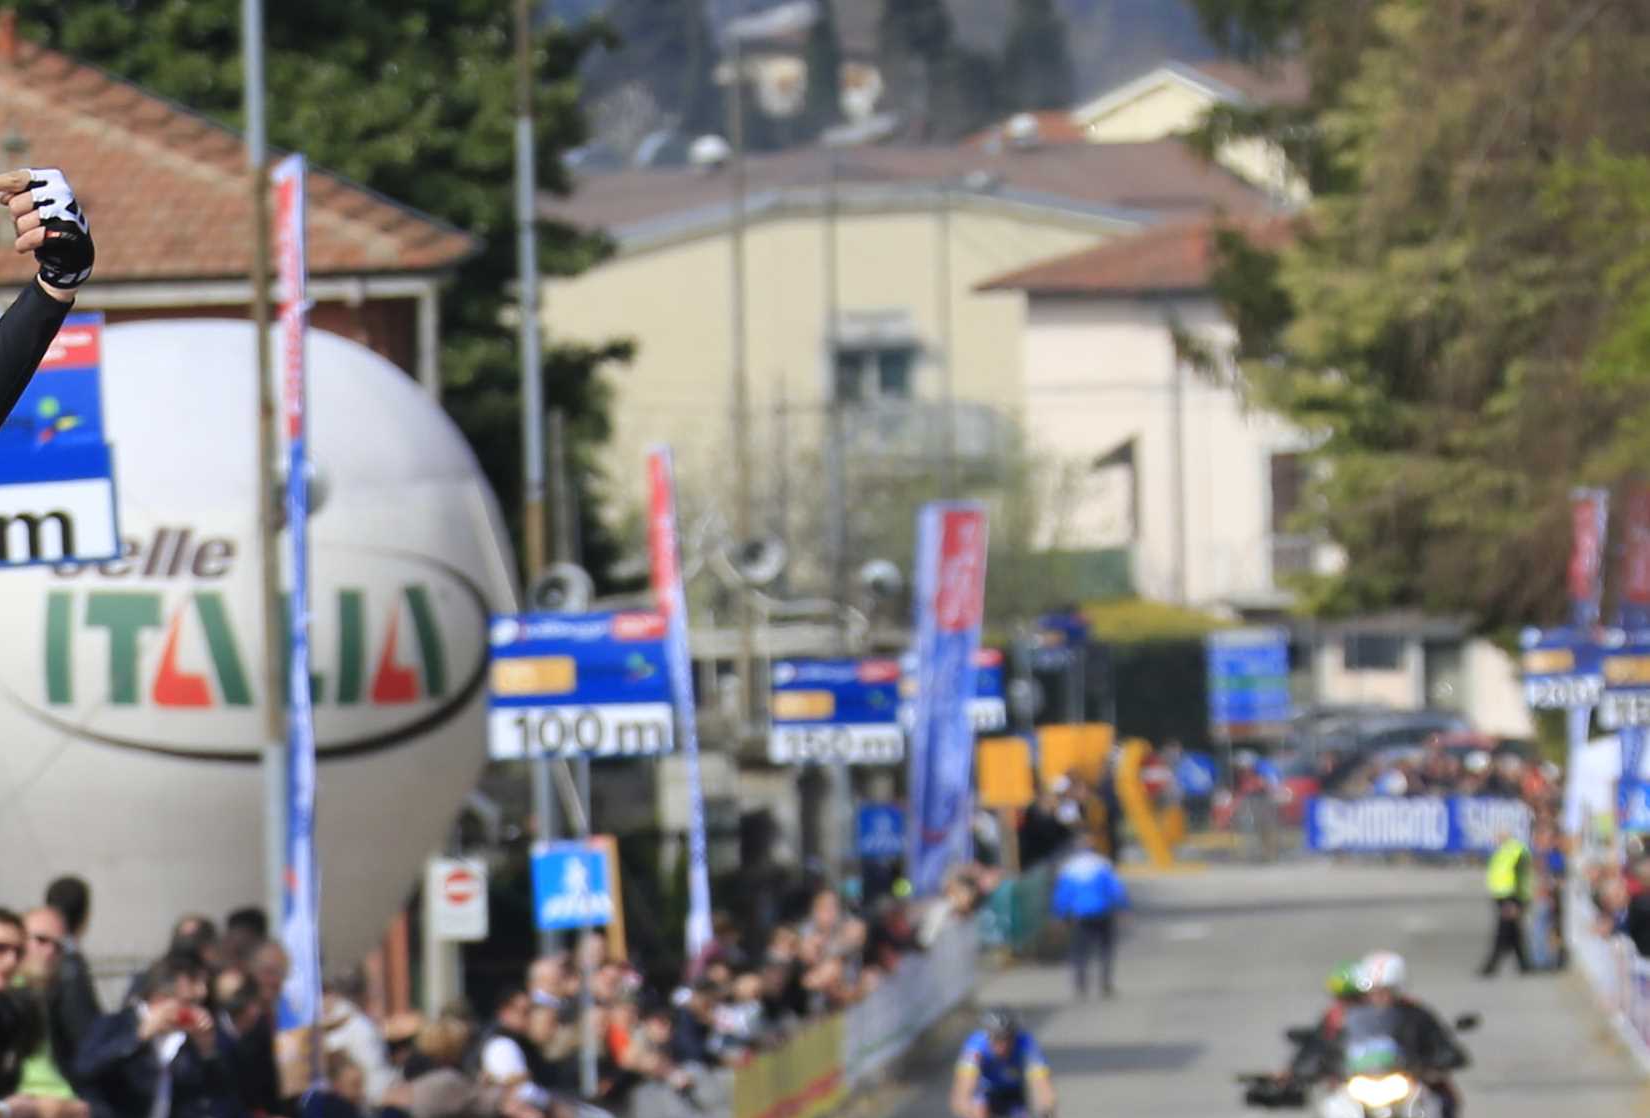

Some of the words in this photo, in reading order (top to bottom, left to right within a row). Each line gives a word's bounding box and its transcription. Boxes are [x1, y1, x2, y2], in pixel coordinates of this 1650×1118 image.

[49, 527, 237, 579] elle
[513, 711, 603, 754] 100
[617, 722, 671, 753] m
